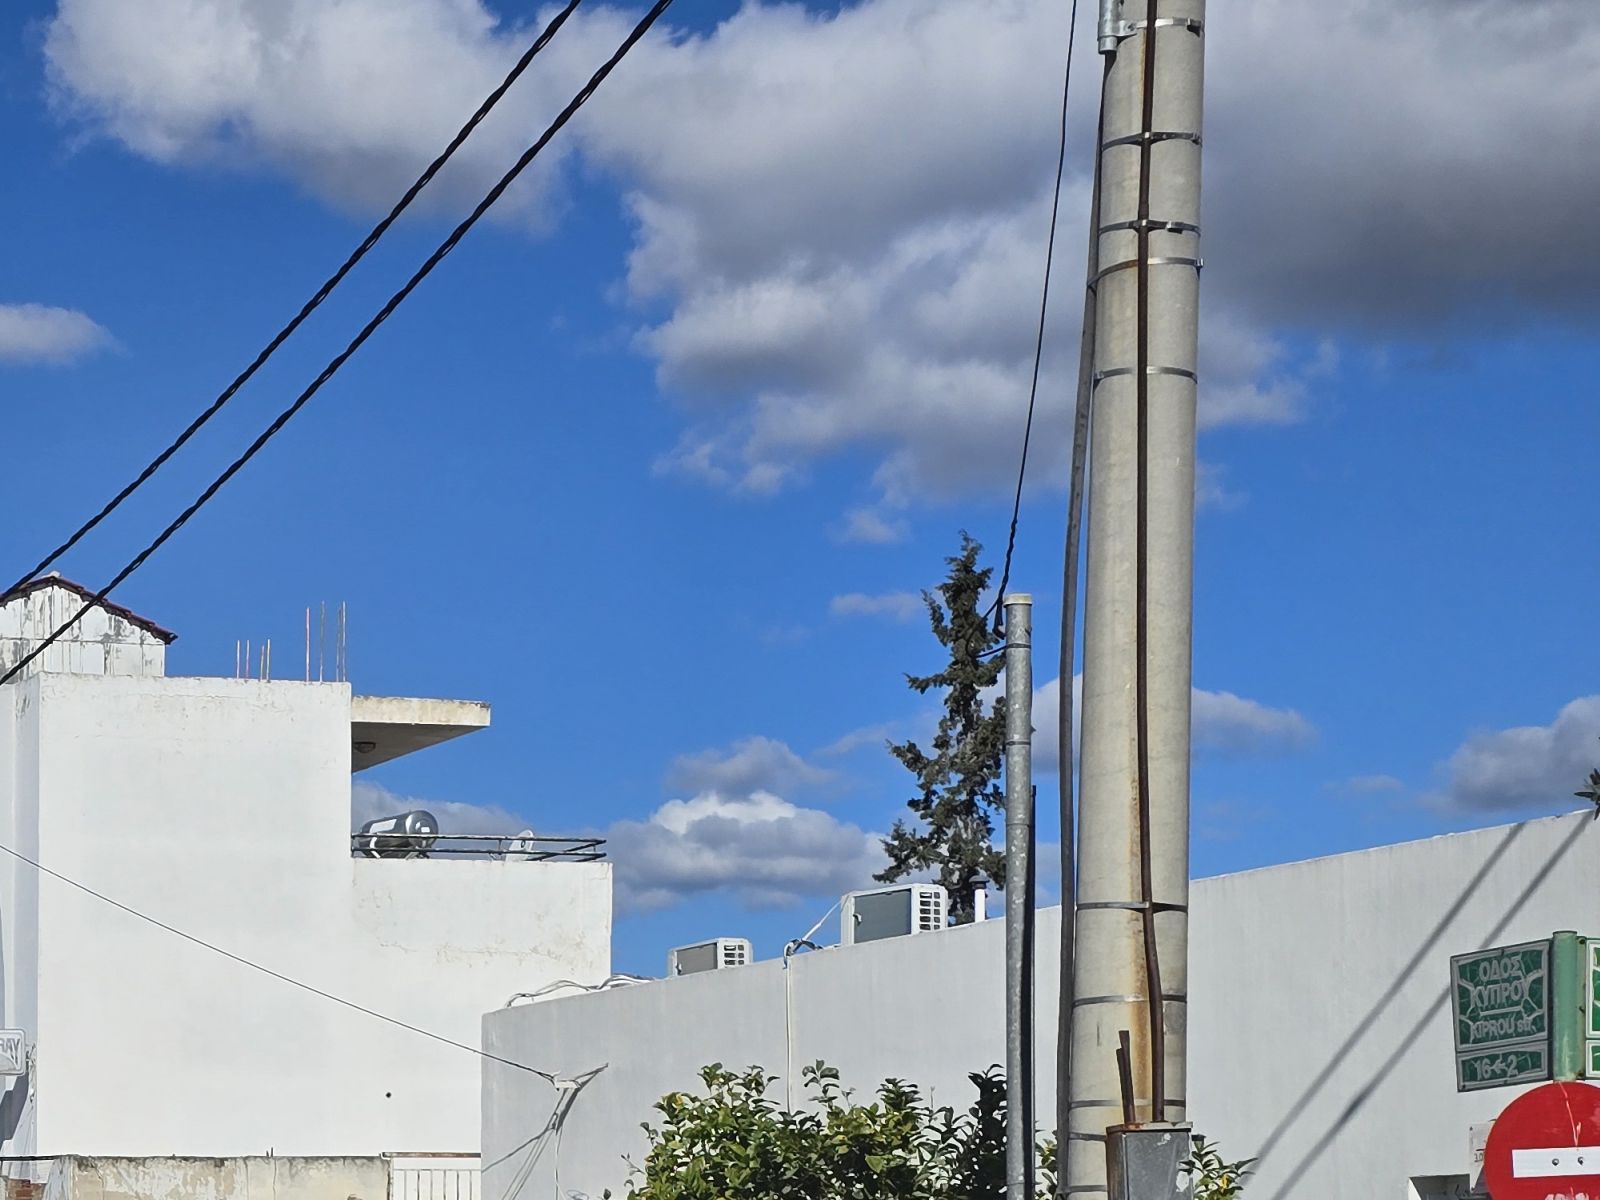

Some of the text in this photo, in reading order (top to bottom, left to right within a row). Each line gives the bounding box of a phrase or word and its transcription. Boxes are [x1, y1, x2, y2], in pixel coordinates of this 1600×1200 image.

[1478, 954, 1523, 983] ΟΔΟΣ
[1471, 1013, 1515, 1041] KIPROU
[1473, 1056, 1492, 1081] 16
